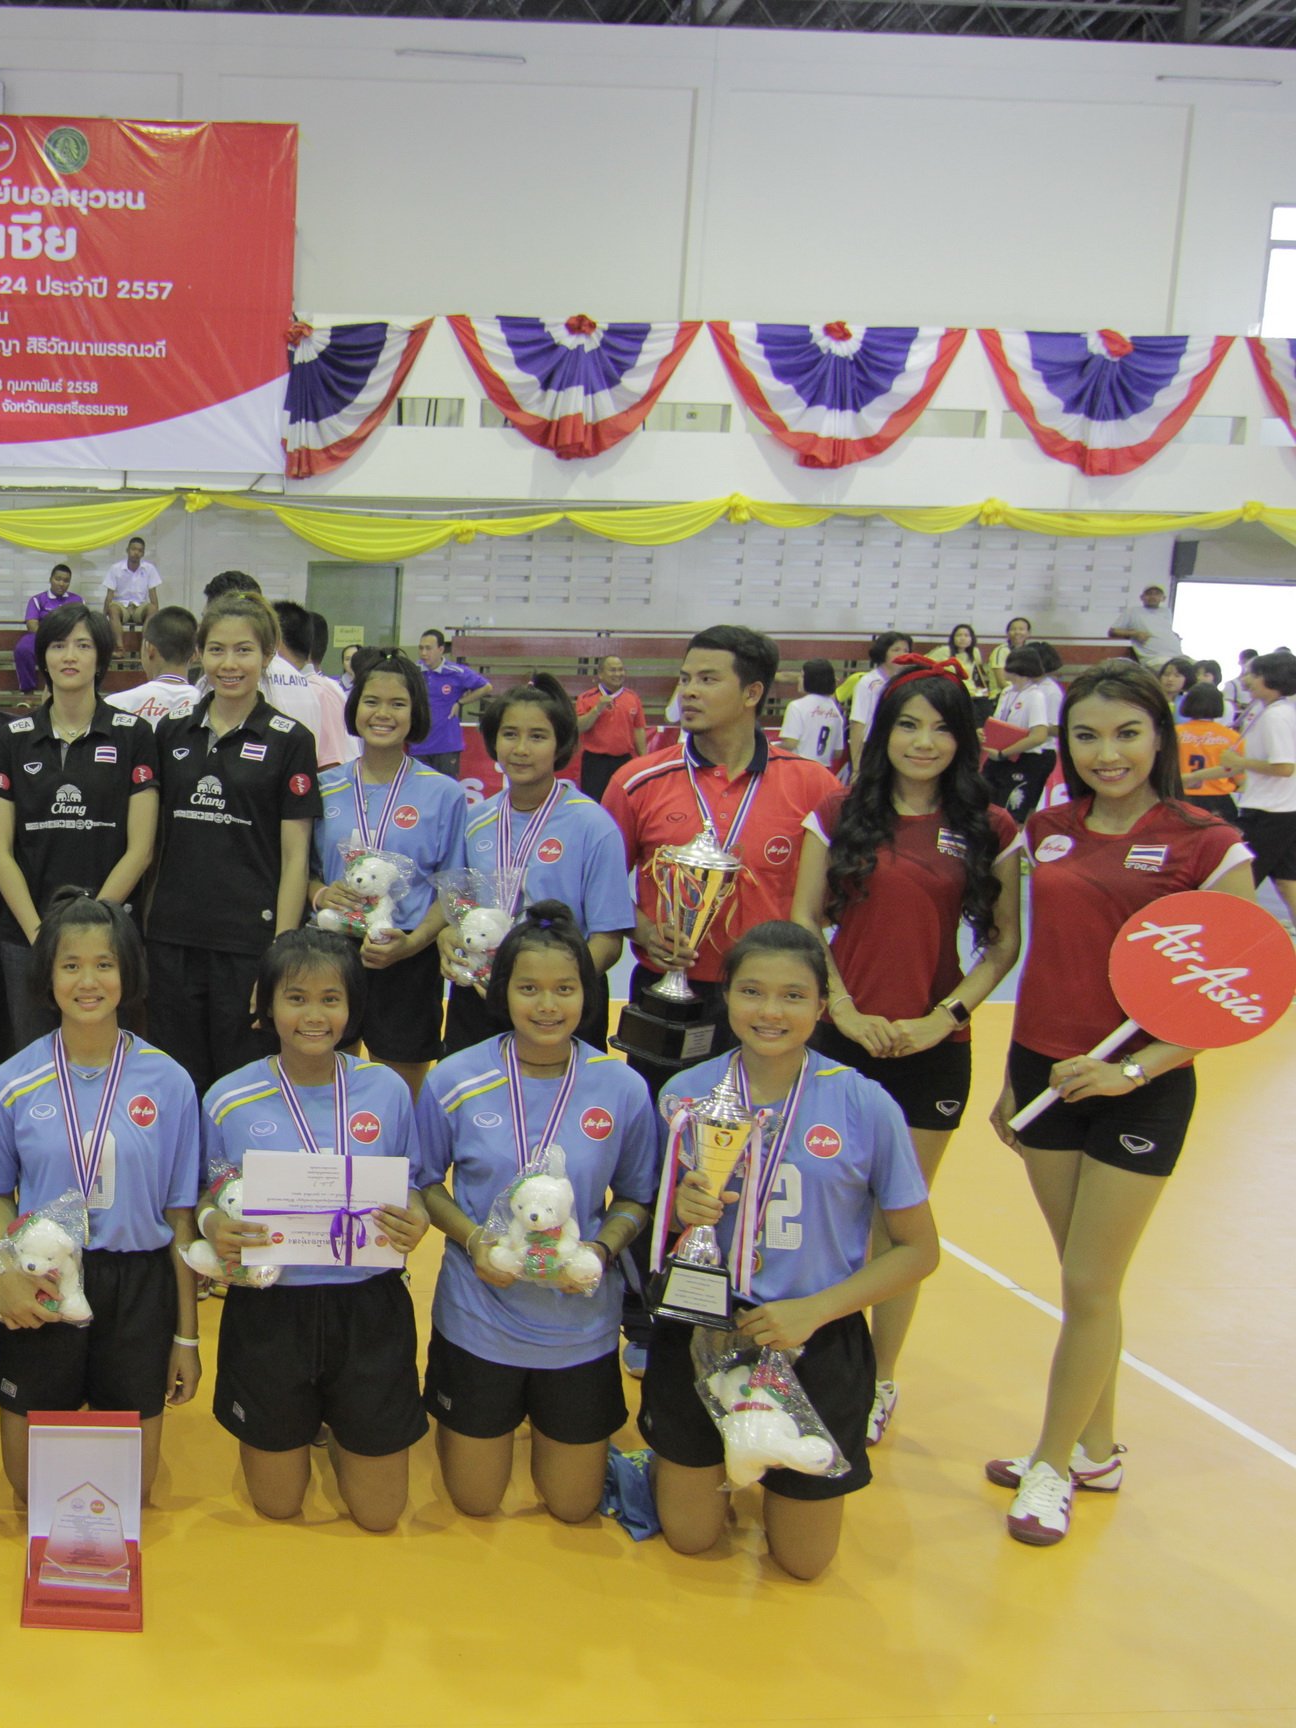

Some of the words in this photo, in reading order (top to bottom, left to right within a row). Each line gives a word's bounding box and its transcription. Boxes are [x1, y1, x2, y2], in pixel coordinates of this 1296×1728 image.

[36, 274, 108, 298] ประจำปี
[116, 280, 173, 300] 2557
[26, 335, 167, 358] สิริวัฒนาพรรณวดี
[7, 378, 63, 395] กุมภาพันธ์
[67, 381, 99, 394] 2558
[2, 399, 129, 416] จังหวัดนครศรีธรรมราช
[12, 720, 31, 729] PEA
[114, 716, 132, 725] PEA
[273, 719, 291, 730] PEA
[51, 802, 87, 816] Chang
[190, 792, 225, 810] Chang
